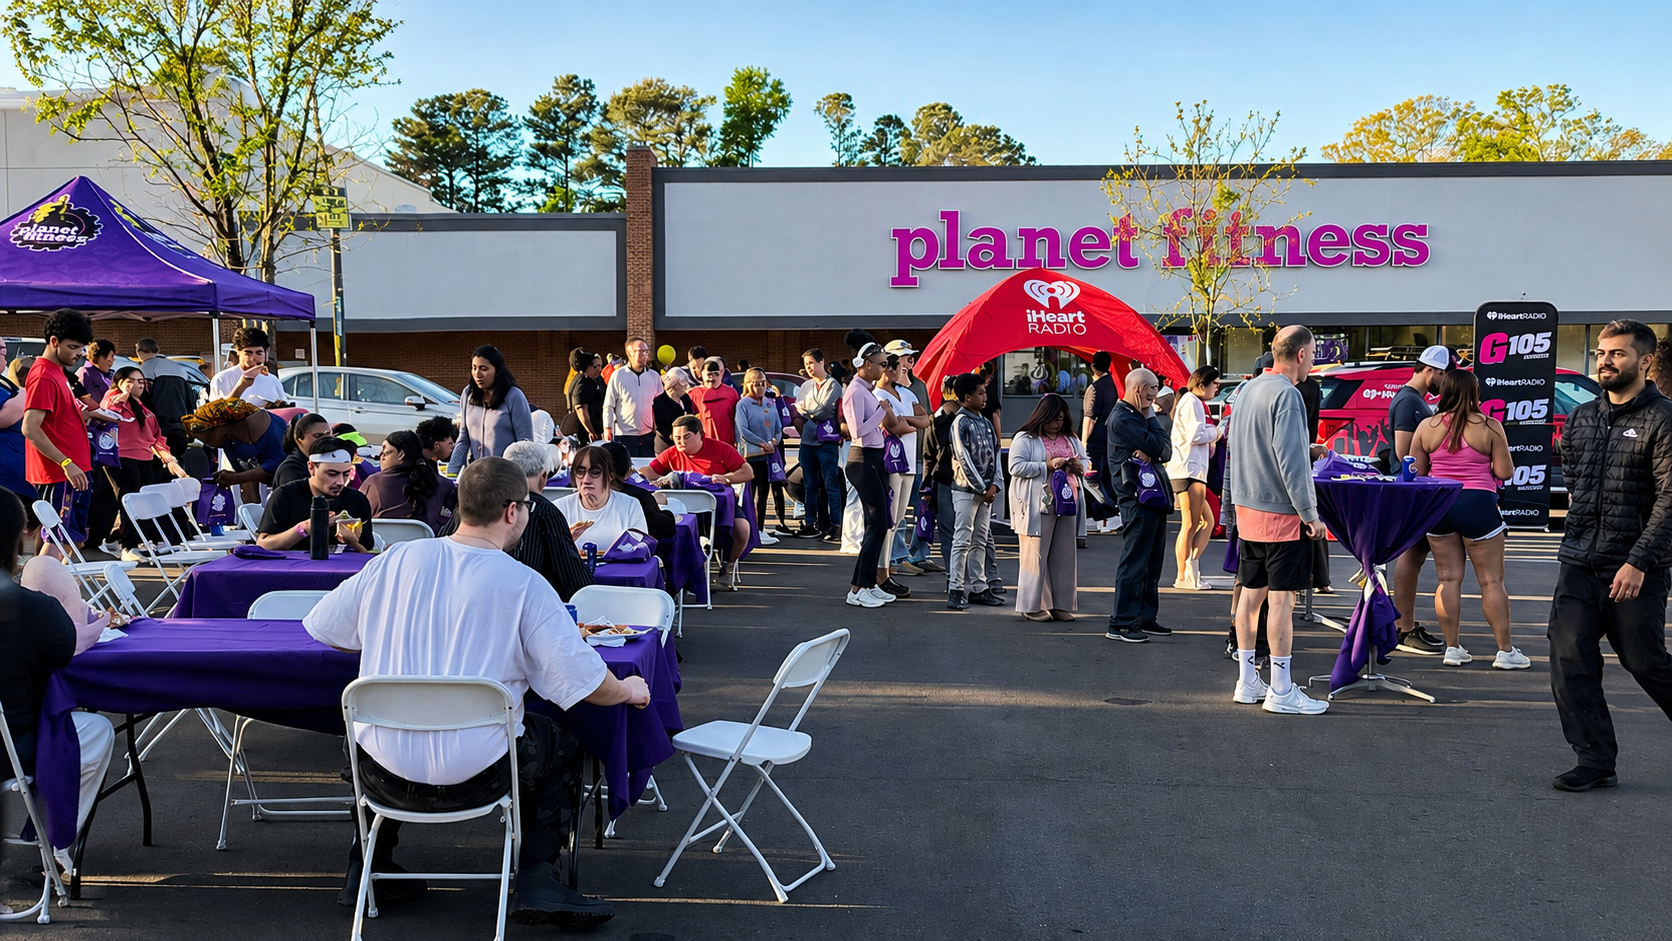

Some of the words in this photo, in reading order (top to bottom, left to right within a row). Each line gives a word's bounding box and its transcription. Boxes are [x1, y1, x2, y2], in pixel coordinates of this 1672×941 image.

[18, 223, 79, 235] planet
[890, 210, 1140, 287] planet
[1161, 207, 1430, 268] fitness
[1026, 309, 1086, 323] iHeart
[1028, 323, 1087, 335] RADIO
[1479, 332, 1552, 365] G105
[1480, 398, 1549, 422] G105
